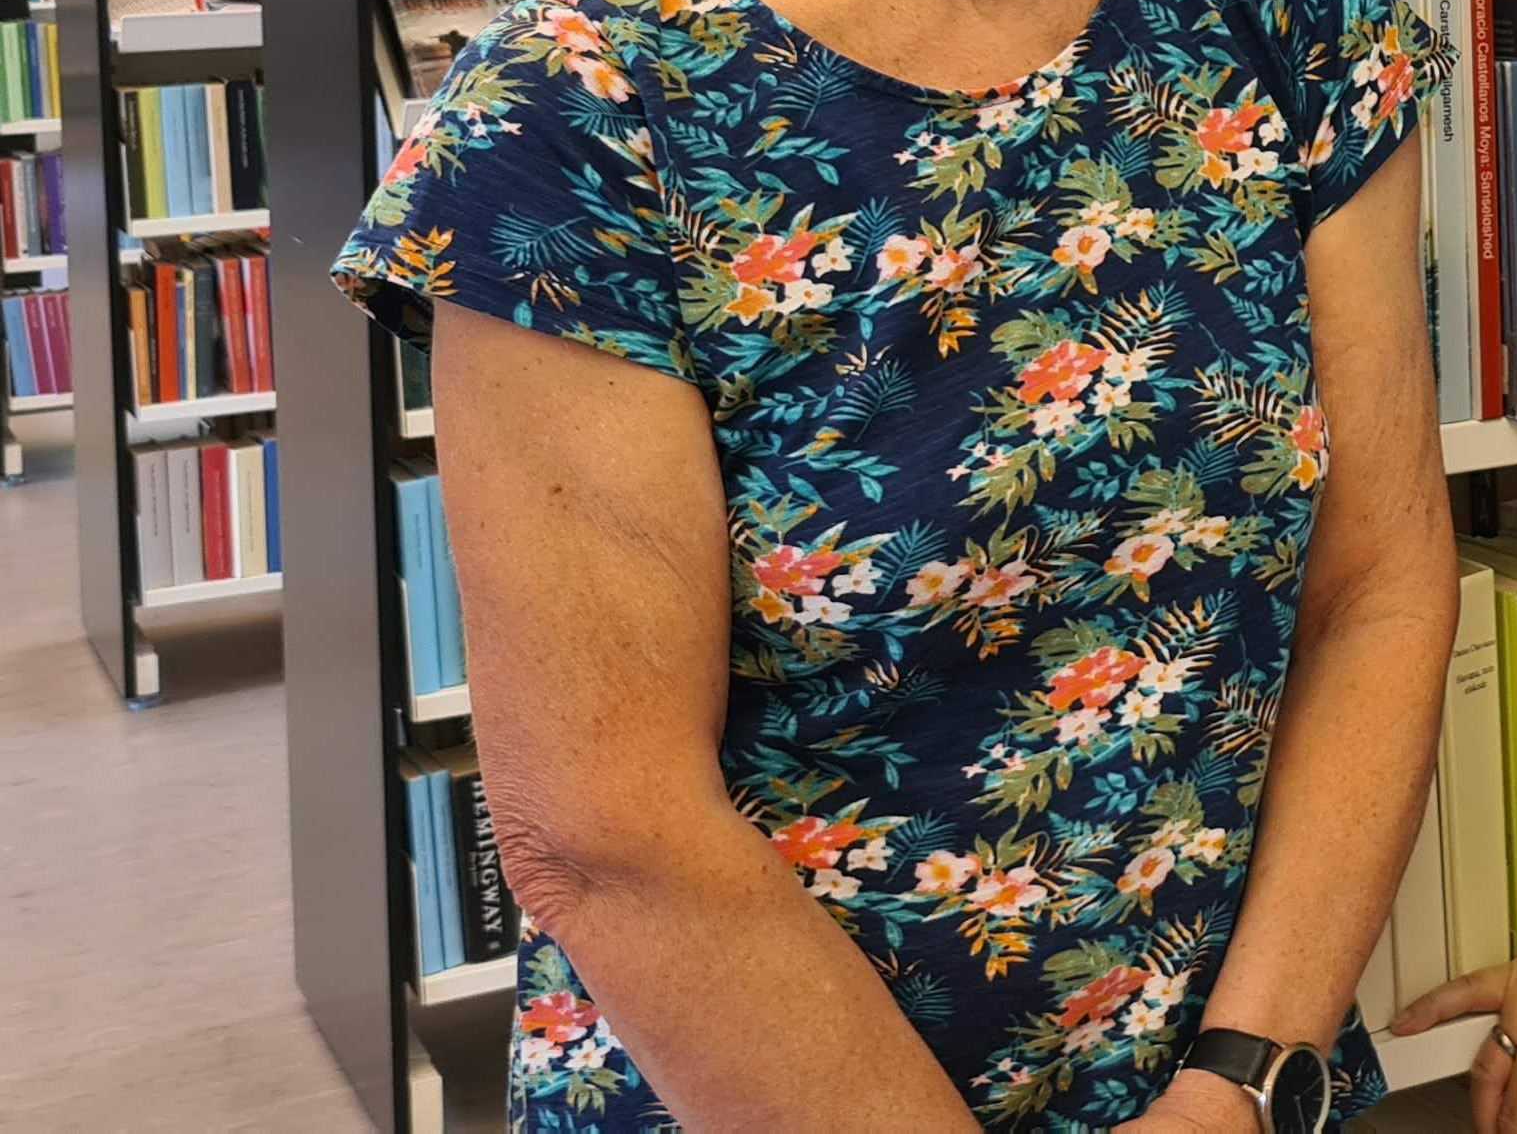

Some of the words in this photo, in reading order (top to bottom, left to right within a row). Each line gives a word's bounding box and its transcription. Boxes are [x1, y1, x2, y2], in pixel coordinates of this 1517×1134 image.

[1477, 42, 1491, 123] Castellanos
[1478, 125, 1493, 168] Moya:
[1481, 171, 1495, 259] Sanseløshed
[471, 780, 503, 934] HEMINGWAY
